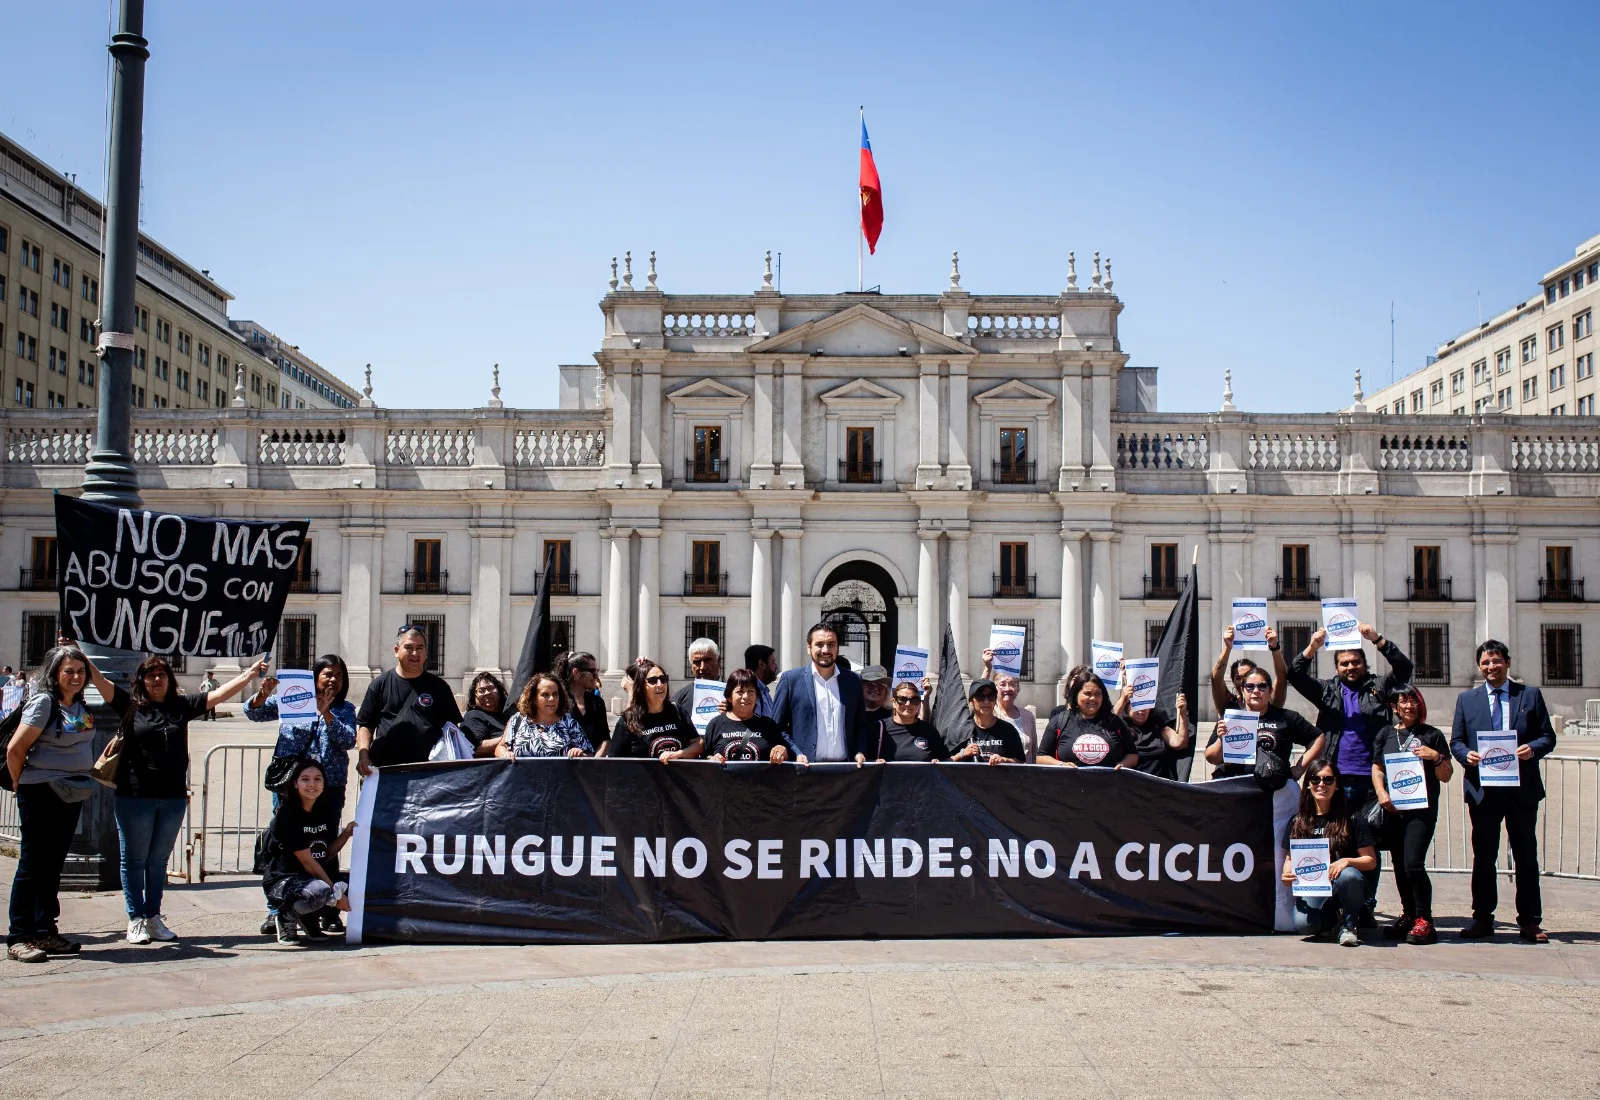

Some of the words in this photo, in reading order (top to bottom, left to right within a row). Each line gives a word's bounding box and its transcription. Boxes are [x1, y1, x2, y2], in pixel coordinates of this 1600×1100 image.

[115, 508, 187, 561] NO
[211, 522, 301, 570] MÁS
[64, 550, 208, 601] ABUSOS
[223, 577, 274, 602] CON
[395, 834, 616, 876] RUNGUE
[634, 838, 707, 878] NO
[723, 839, 782, 879] SE
[800, 838, 972, 878] RINDE:
[989, 839, 1055, 878] NO
[1069, 842, 1101, 879] A
[1116, 843, 1253, 881] CICLO
